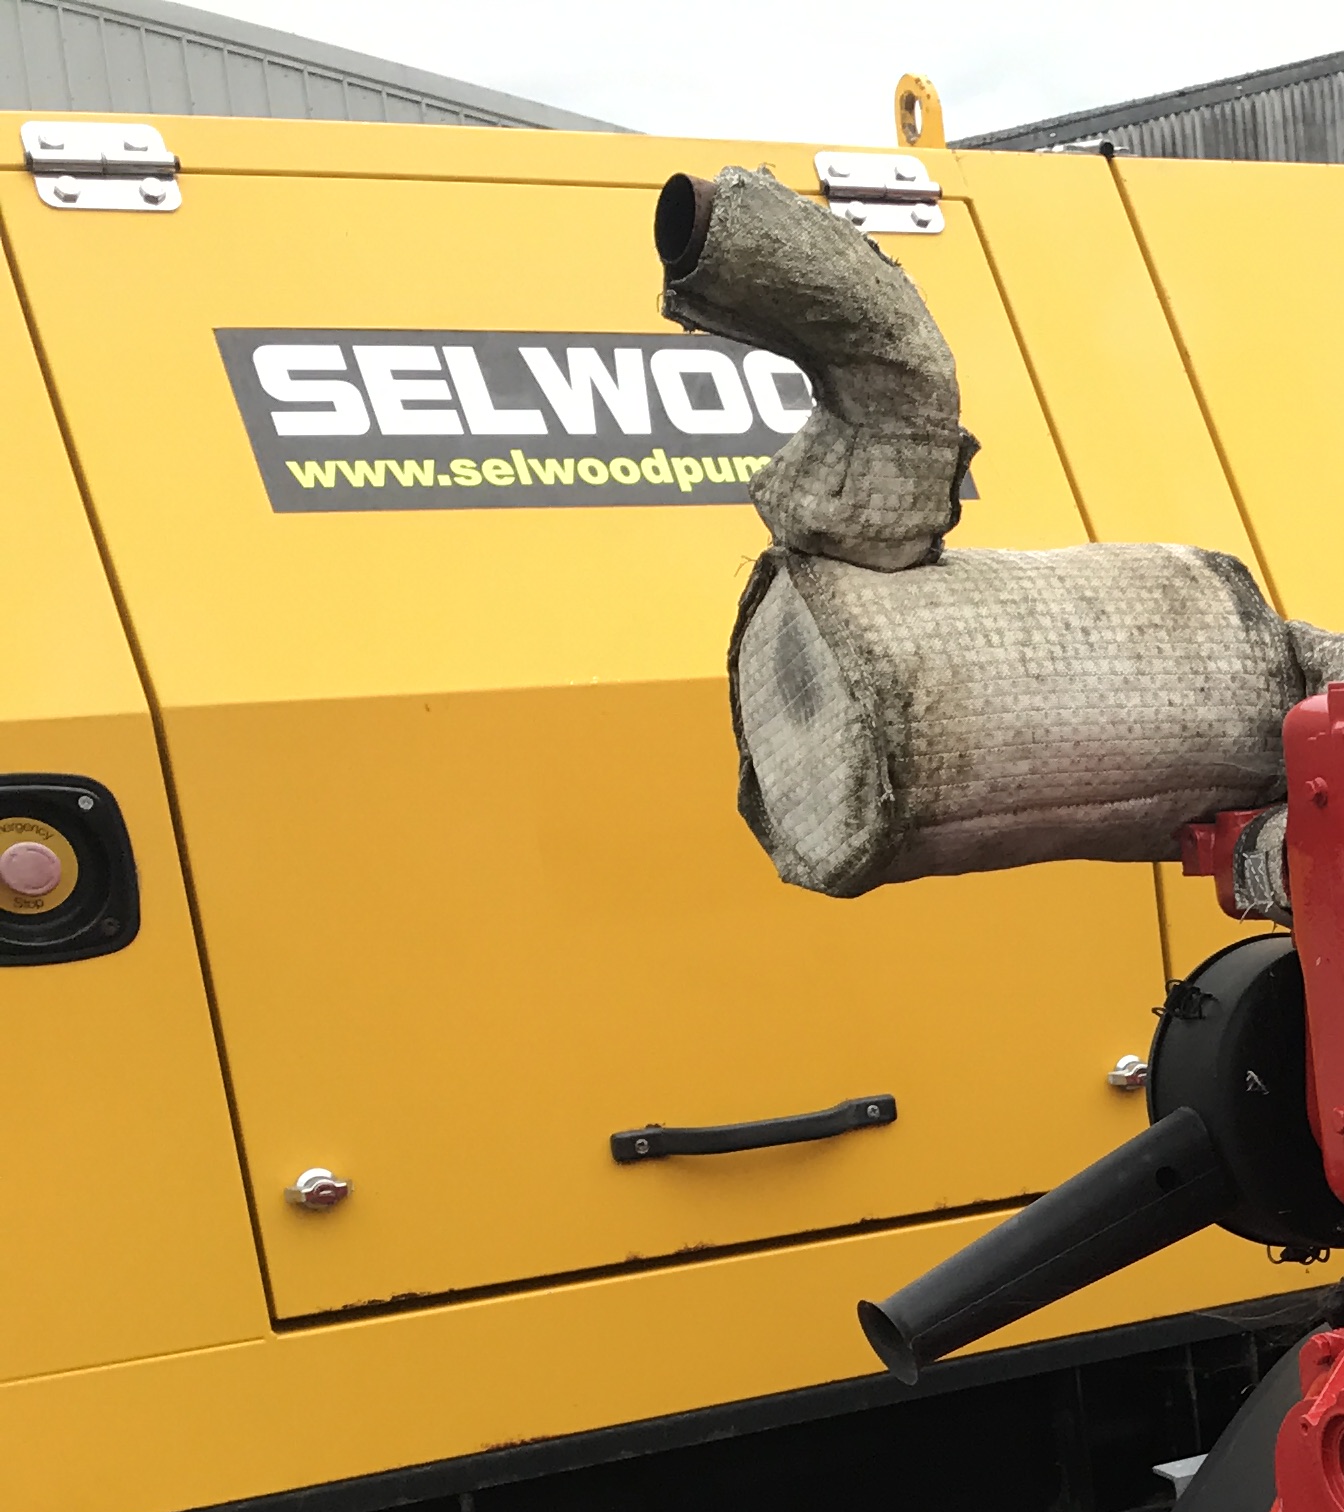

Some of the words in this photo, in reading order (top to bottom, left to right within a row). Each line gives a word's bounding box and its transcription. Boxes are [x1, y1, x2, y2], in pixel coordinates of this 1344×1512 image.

[253, 344, 818, 437] SELWOO
[286, 449, 772, 492] www.selwoodpum
[13, 897, 45, 910] Stop
